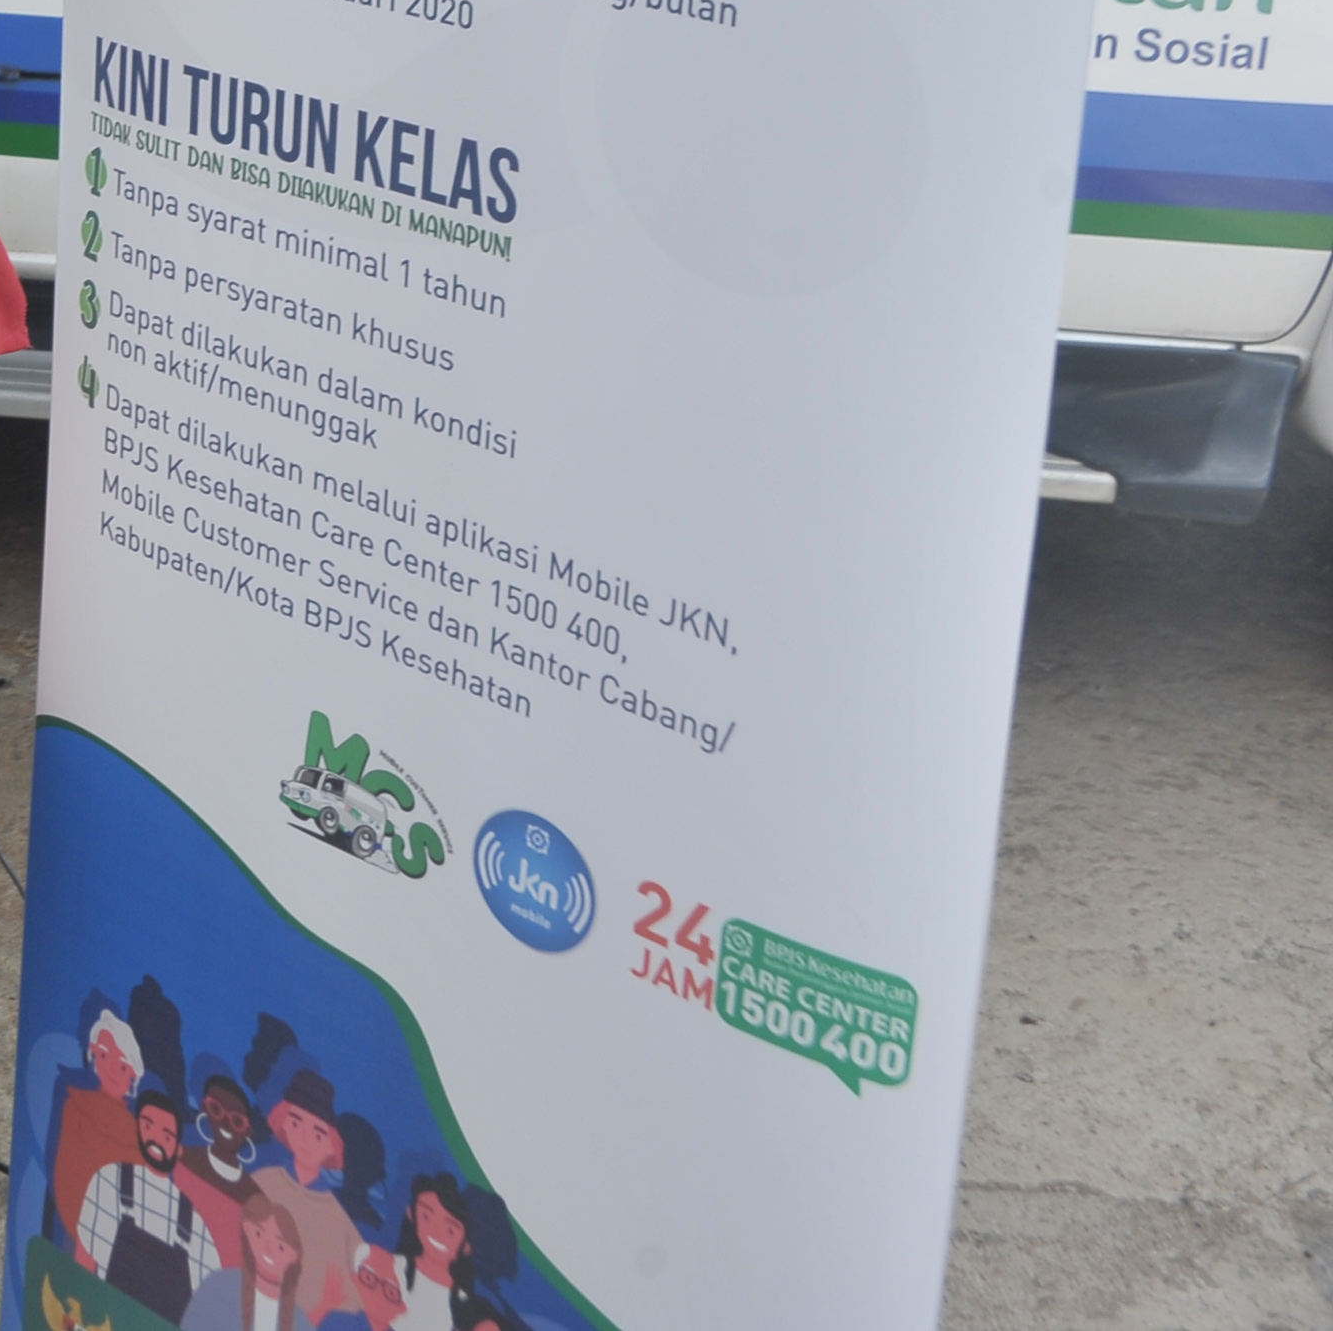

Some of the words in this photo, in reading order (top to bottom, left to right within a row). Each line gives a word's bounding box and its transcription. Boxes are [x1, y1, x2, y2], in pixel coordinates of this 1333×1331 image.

[1134, 28, 1270, 71] Sosial
[91, 111, 131, 146] TIDAK
[136, 130, 181, 161] SULIT
[187, 146, 223, 175] DAN
[231, 158, 270, 189] BISA
[277, 171, 374, 219] DILAKUKAN
[381, 201, 402, 227] DI
[408, 209, 512, 262] MANAPUN!
[95, 36, 169, 126] KINI
[183, 64, 339, 174] TURUN
[354, 110, 519, 223] KELAS
[83, 210, 100, 262] 2
[111, 231, 176, 280] Tanpa
[185, 267, 341, 335] persyaratan
[352, 312, 454, 371] khusus
[113, 168, 178, 217] Tanpa
[187, 203, 266, 244] syarat
[275, 229, 389, 282] minimal
[401, 259, 410, 288] 1
[423, 268, 505, 318] tahun
[81, 280, 98, 329] 3
[110, 290, 173, 339] Dapat
[182, 321, 307, 386] dilakukan
[318, 367, 403, 419] dalam
[414, 397, 517, 459] kondisi
[108, 333, 146, 365] non
[154, 350, 377, 449] aktif/menunggak
[104, 427, 158, 473] BPJS
[167, 454, 301, 530] Kesehatan
[312, 511, 374, 556] Care
[384, 539, 480, 596] Center
[492, 580, 557, 629] 1500
[566, 612, 627, 664] 400,
[107, 384, 170, 434] Dapat
[178, 417, 302, 484] dilakukan
[313, 471, 416, 526] melalui
[426, 514, 538, 573] aplikasi
[549, 552, 649, 616] Mobile
[659, 598, 737, 656] JKN,
[100, 511, 294, 618] Kabupaten/Kota
[305, 598, 371, 648] BPJS
[382, 630, 531, 718] Kesehatan
[102, 469, 175, 524] Mobile
[184, 507, 311, 576] Customer
[318, 559, 418, 621] Service
[428, 605, 478, 647] dan
[490, 627, 591, 691] Kantor
[600, 674, 736, 754] Cabang/
[304, 710, 445, 879] MCS
[630, 947, 715, 1012] JAM
[633, 880, 715, 967] 24
[763, 938, 805, 967] BPJS
[808, 955, 915, 1005] Kesehatan
[720, 981, 816, 1047] 1500
[820, 1024, 908, 1081] 400
[721, 955, 792, 1001] CARE
[796, 985, 910, 1044] CENTER
